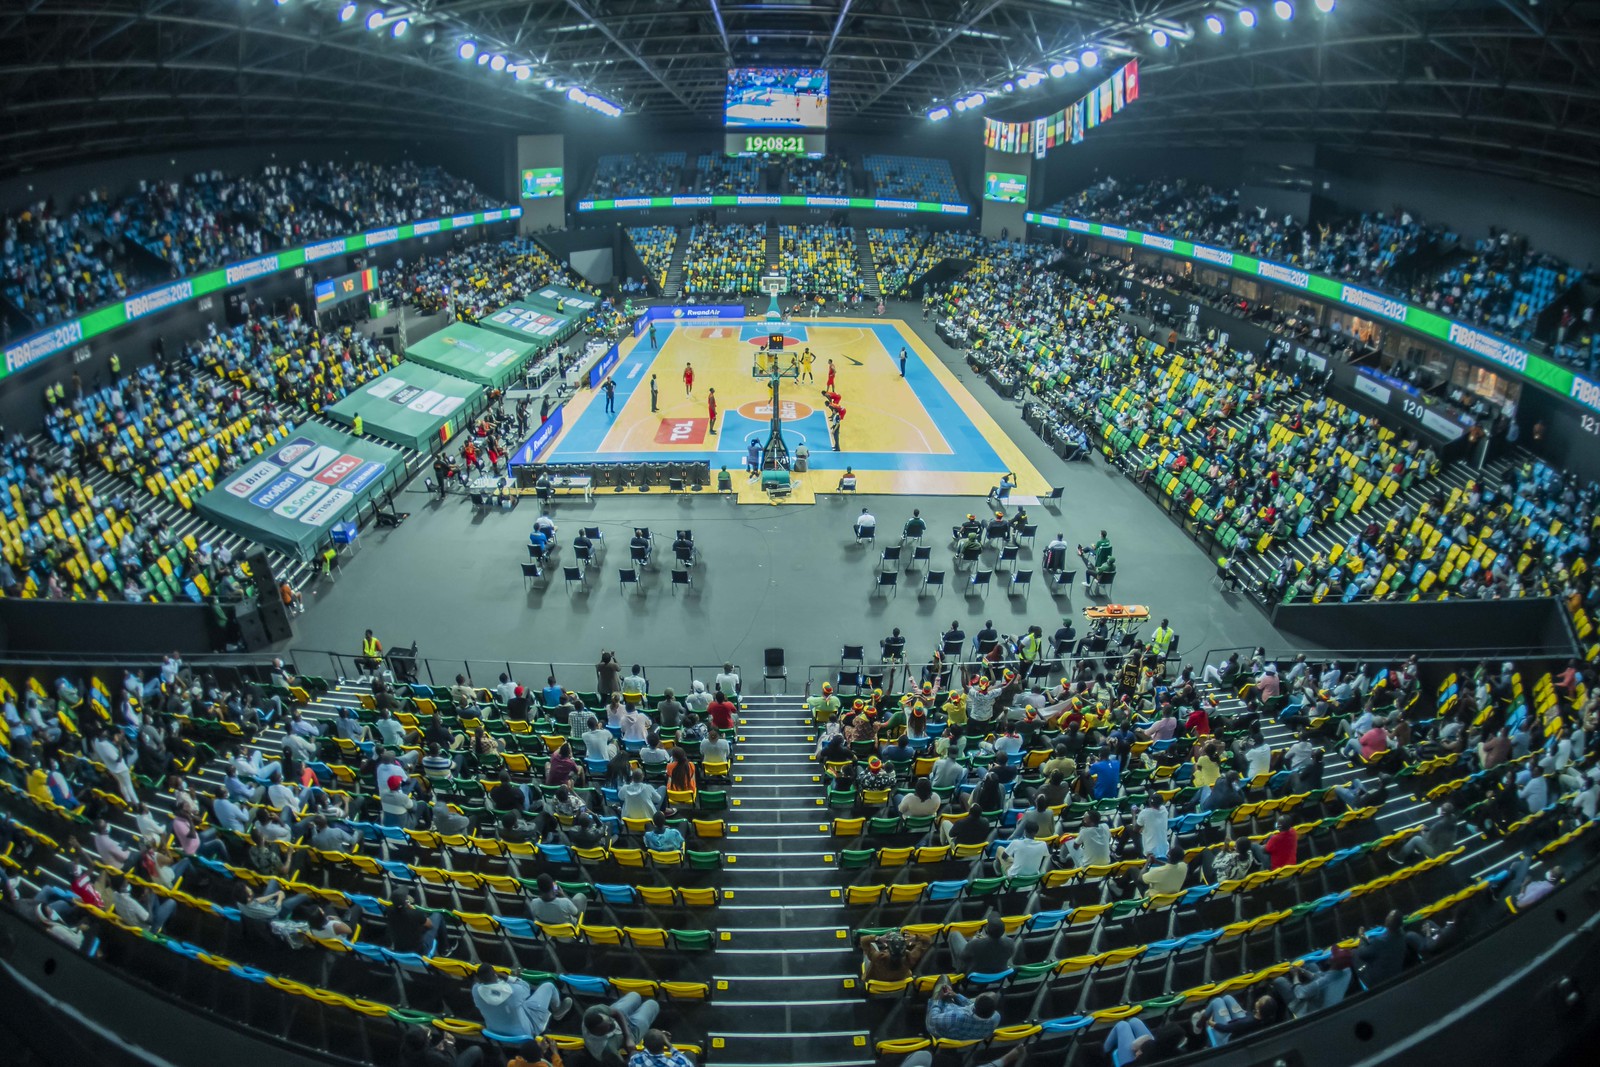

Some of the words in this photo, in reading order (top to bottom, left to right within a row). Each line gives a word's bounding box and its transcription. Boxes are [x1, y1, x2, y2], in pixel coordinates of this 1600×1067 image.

[745, 136, 804, 152] 19:08:21
[1258, 260, 1275, 279] FIBA
[1291, 270, 1310, 288] 2021
[342, 279, 354, 292] VS
[126, 295, 150, 320] FIBA
[170, 281, 193, 303] 2021
[1342, 285, 1363, 306] FIBA
[1384, 300, 1408, 322] 2021
[6, 343, 33, 372] FIBA
[55, 320, 83, 348] 2021
[73, 344, 92, 364] 105
[1450, 322, 1477, 350] FIBA
[1502, 344, 1530, 372] 2021
[1402, 398, 1424, 420] 120
[670, 420, 694, 442] TCL
[1581, 414, 1600, 436] 121
[323, 461, 355, 479] TCL
[258, 476, 297, 505] molten
[292, 485, 322, 506] Smart
[318, 491, 342, 513] TISSOT
